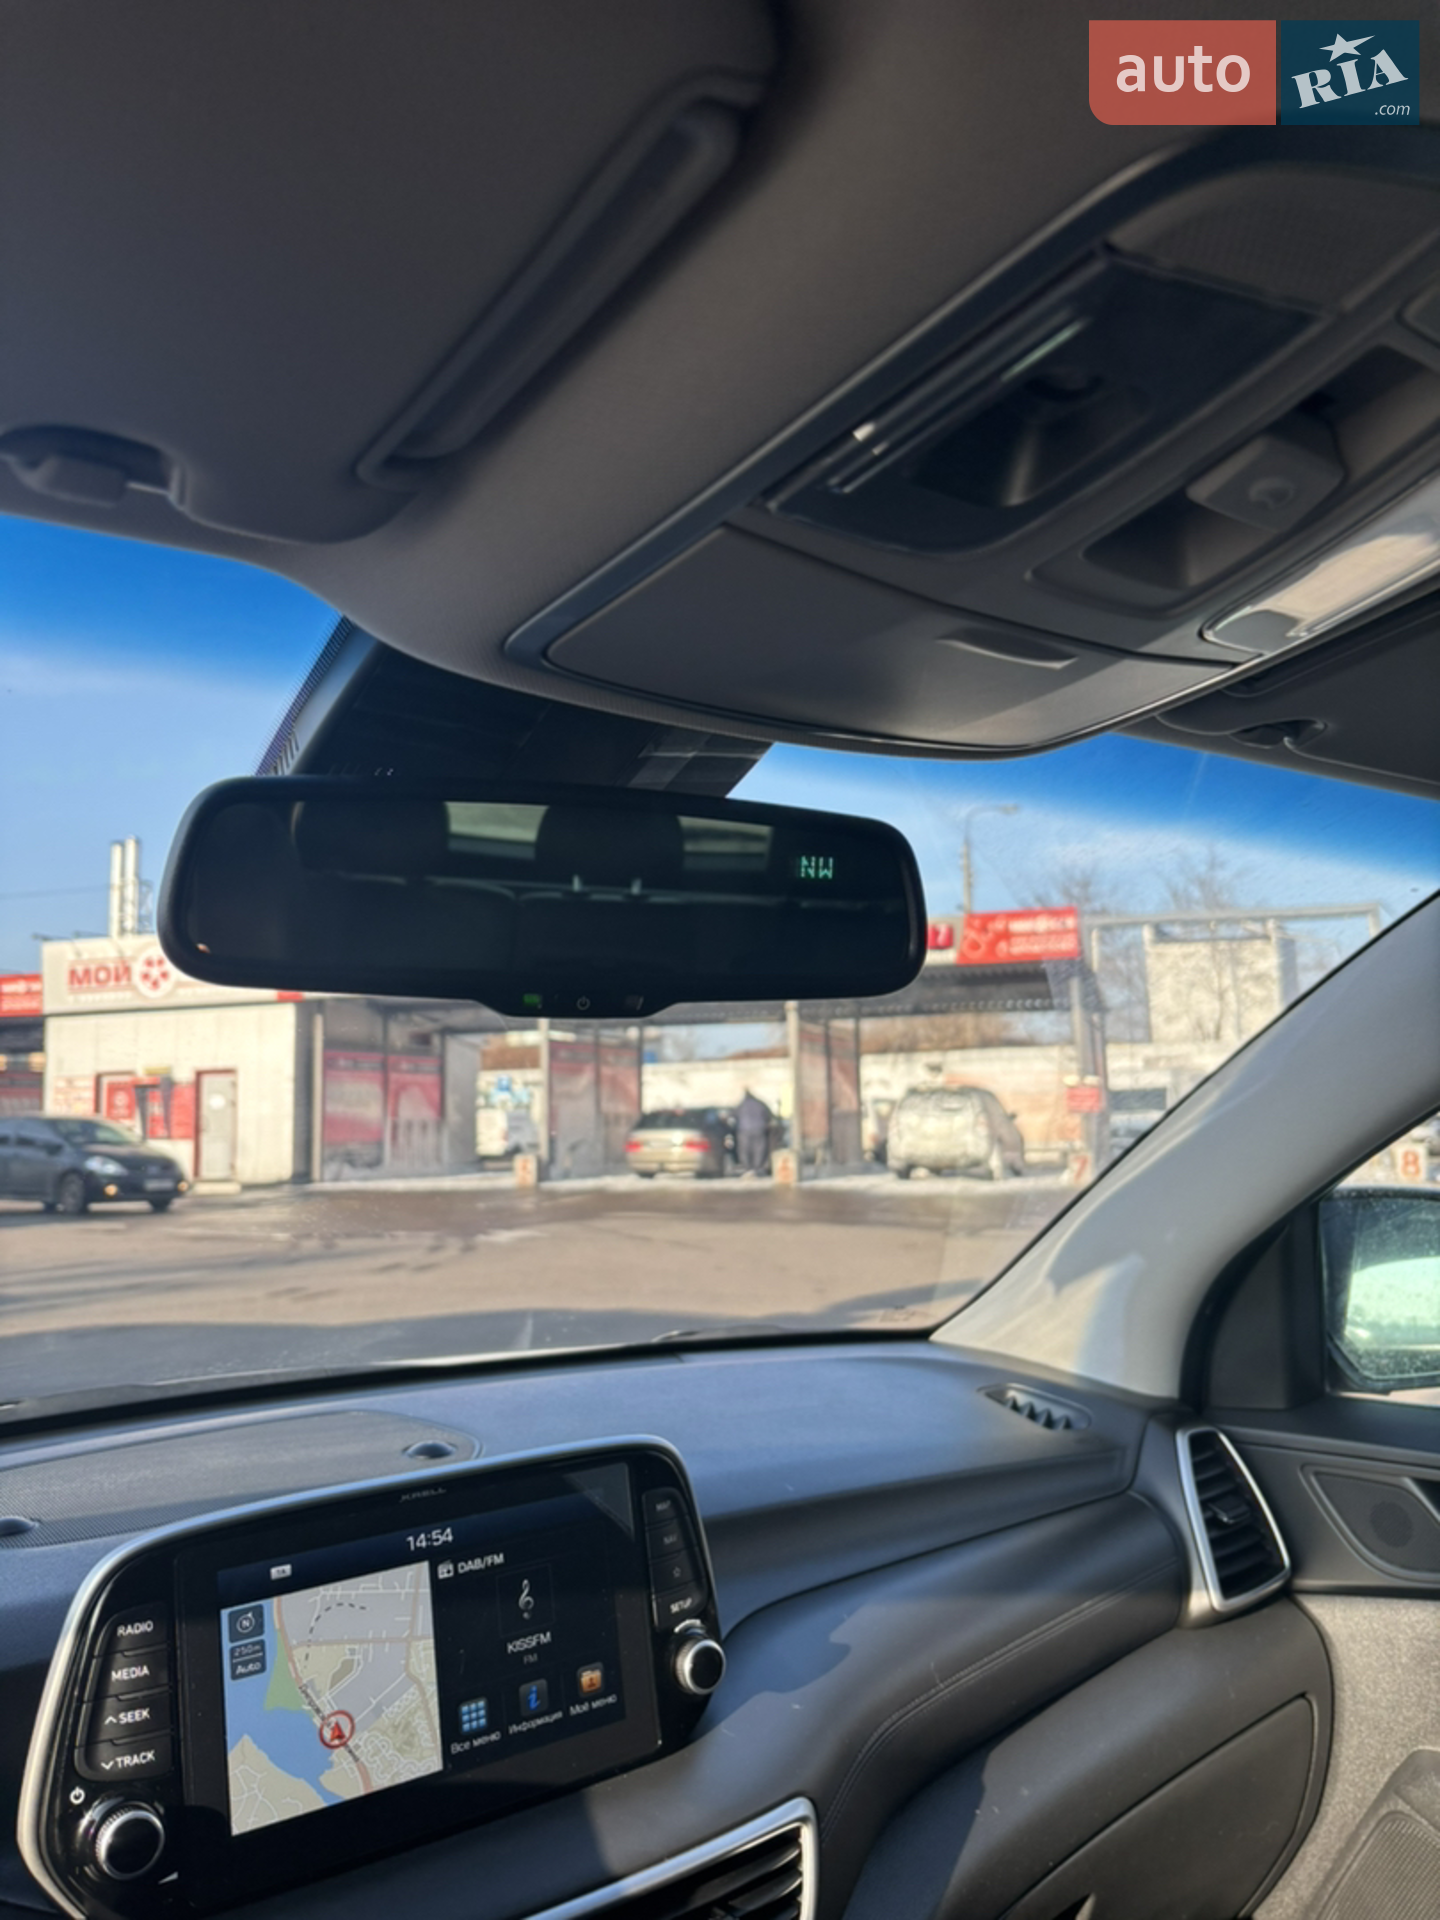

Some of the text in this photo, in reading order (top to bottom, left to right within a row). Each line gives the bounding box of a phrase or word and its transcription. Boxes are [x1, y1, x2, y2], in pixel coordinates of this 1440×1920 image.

[800, 855, 833, 879] NW
[68, 960, 132, 987] МОЙ
[1401, 1149, 1421, 1178] 8
[406, 1527, 454, 1551] 14:54
[457, 1552, 505, 1574] DAB/FM
[670, 1597, 692, 1614] SETUP
[117, 1620, 154, 1637] RADIO
[506, 1631, 552, 1654] KISSFM
[236, 1661, 262, 1676] Auto
[523, 1653, 538, 1665] FM
[111, 1664, 150, 1682] MEDIA
[591, 1694, 618, 1710] меню
[119, 1707, 151, 1725] SEEK
[508, 1711, 564, 1735] Информация
[450, 1731, 502, 1755] Все меню
[115, 1749, 156, 1769] TRACK
